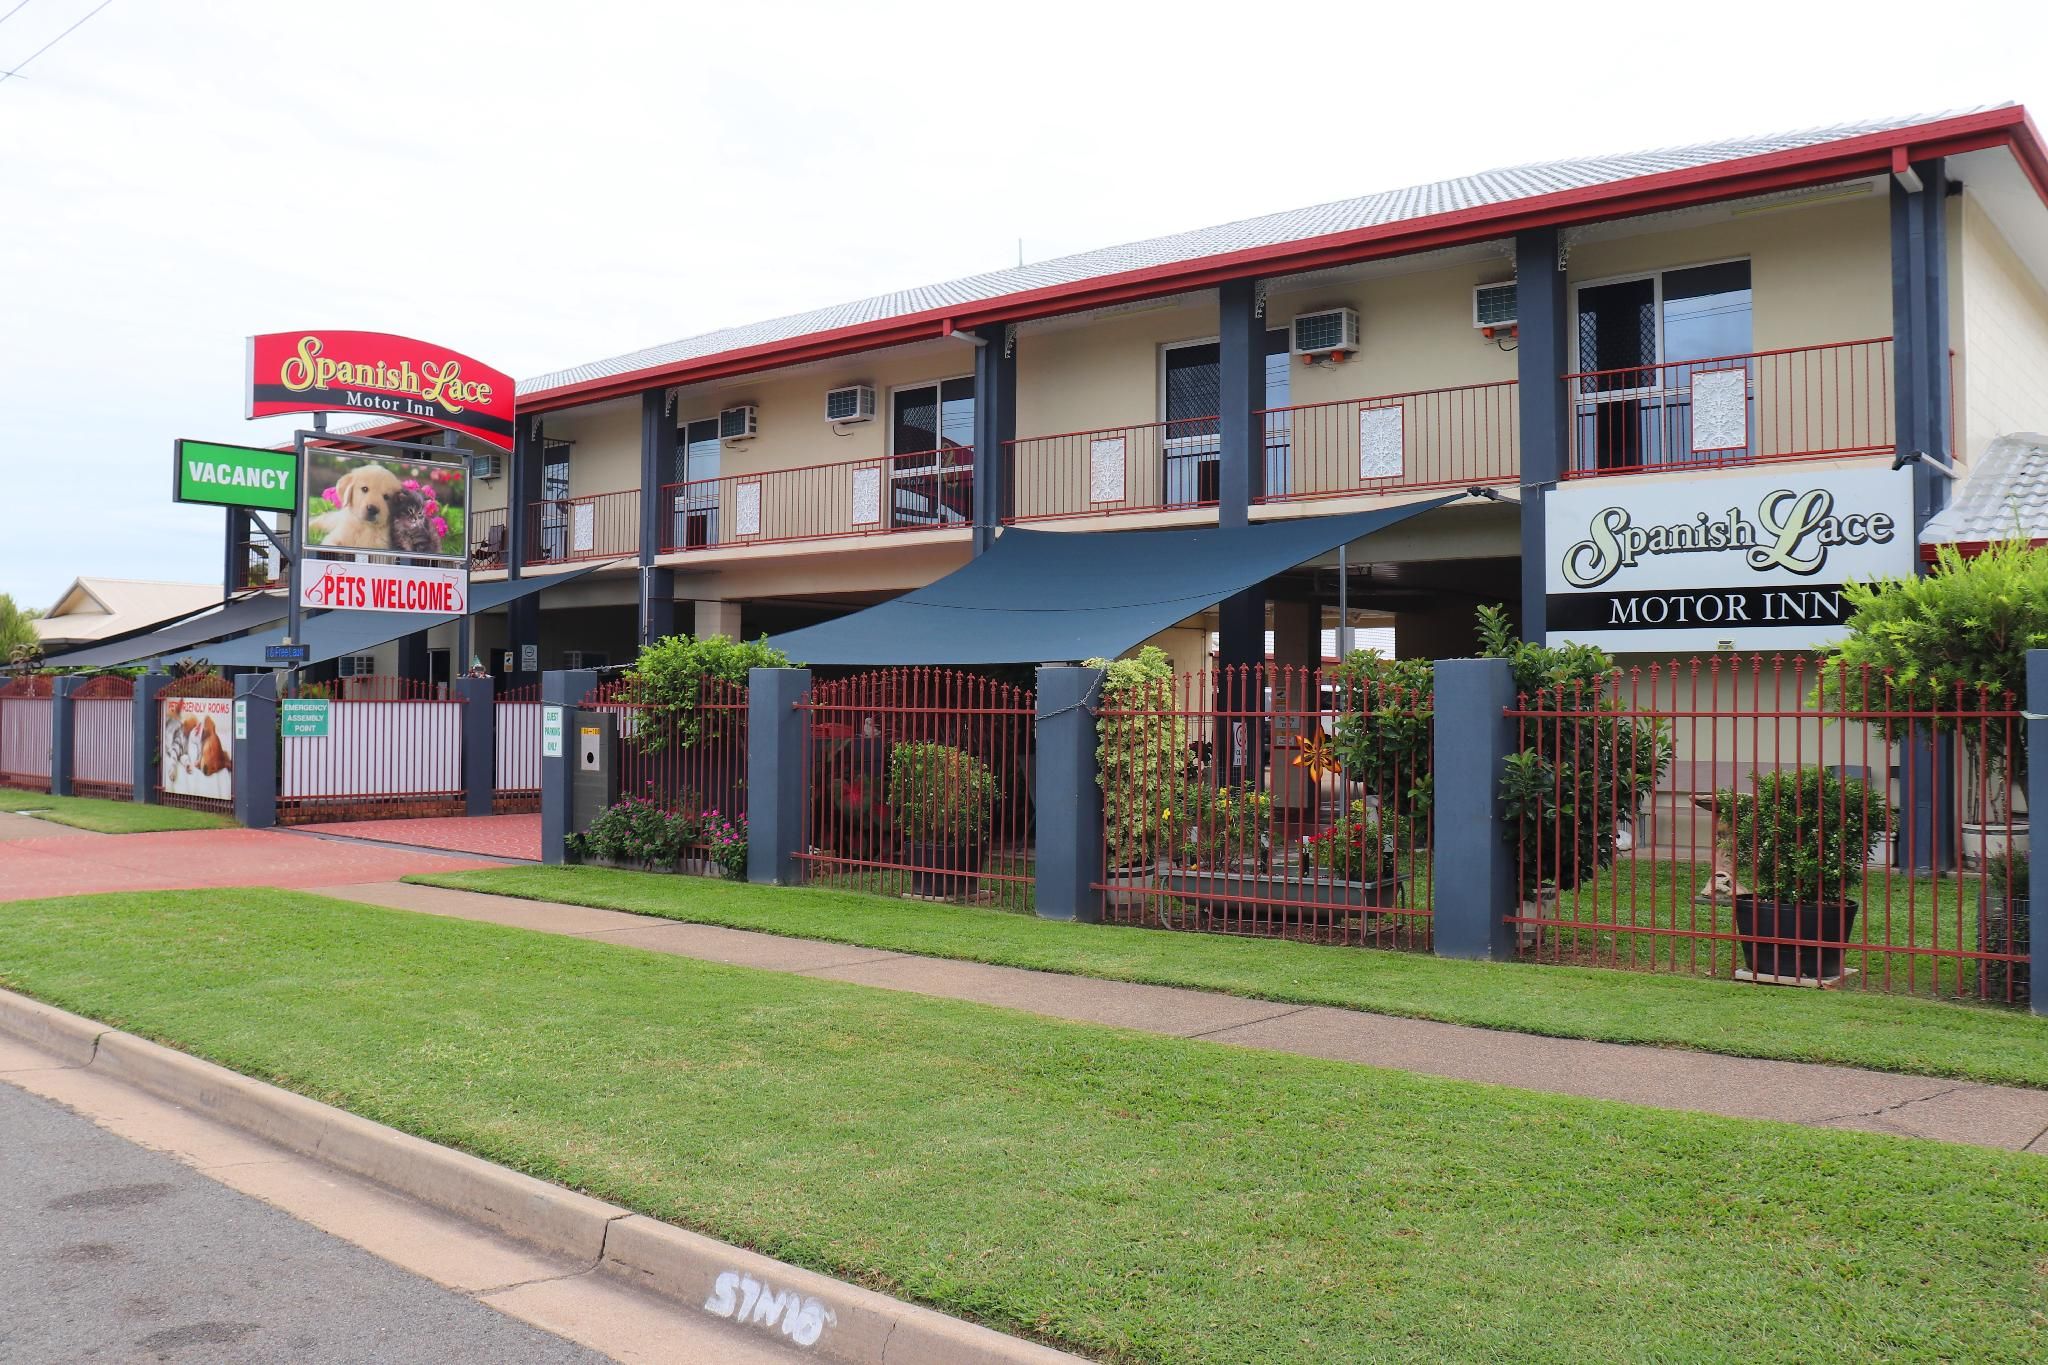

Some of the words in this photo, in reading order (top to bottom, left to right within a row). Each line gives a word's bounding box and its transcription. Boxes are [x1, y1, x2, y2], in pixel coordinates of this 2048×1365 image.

[281, 336, 420, 393] Spanish
[421, 360, 492, 414] Lace
[346, 390, 400, 412] Motor
[406, 399, 435, 417] Inn
[188, 461, 289, 491] VACANCY
[1562, 506, 1757, 588] Spanish
[1746, 489, 1894, 575] Lace
[324, 575, 366, 608] PETS
[371, 579, 453, 611] WELCOME
[1608, 593, 1752, 624] MOTOR
[1762, 591, 1843, 621] INN
[208, 702, 230, 714] ROOMS
[284, 703, 327, 711] EMERGENCY
[287, 714, 324, 722] ASSEMBLY
[547, 712, 558, 721] GUEST
[294, 724, 316, 732] POINT
